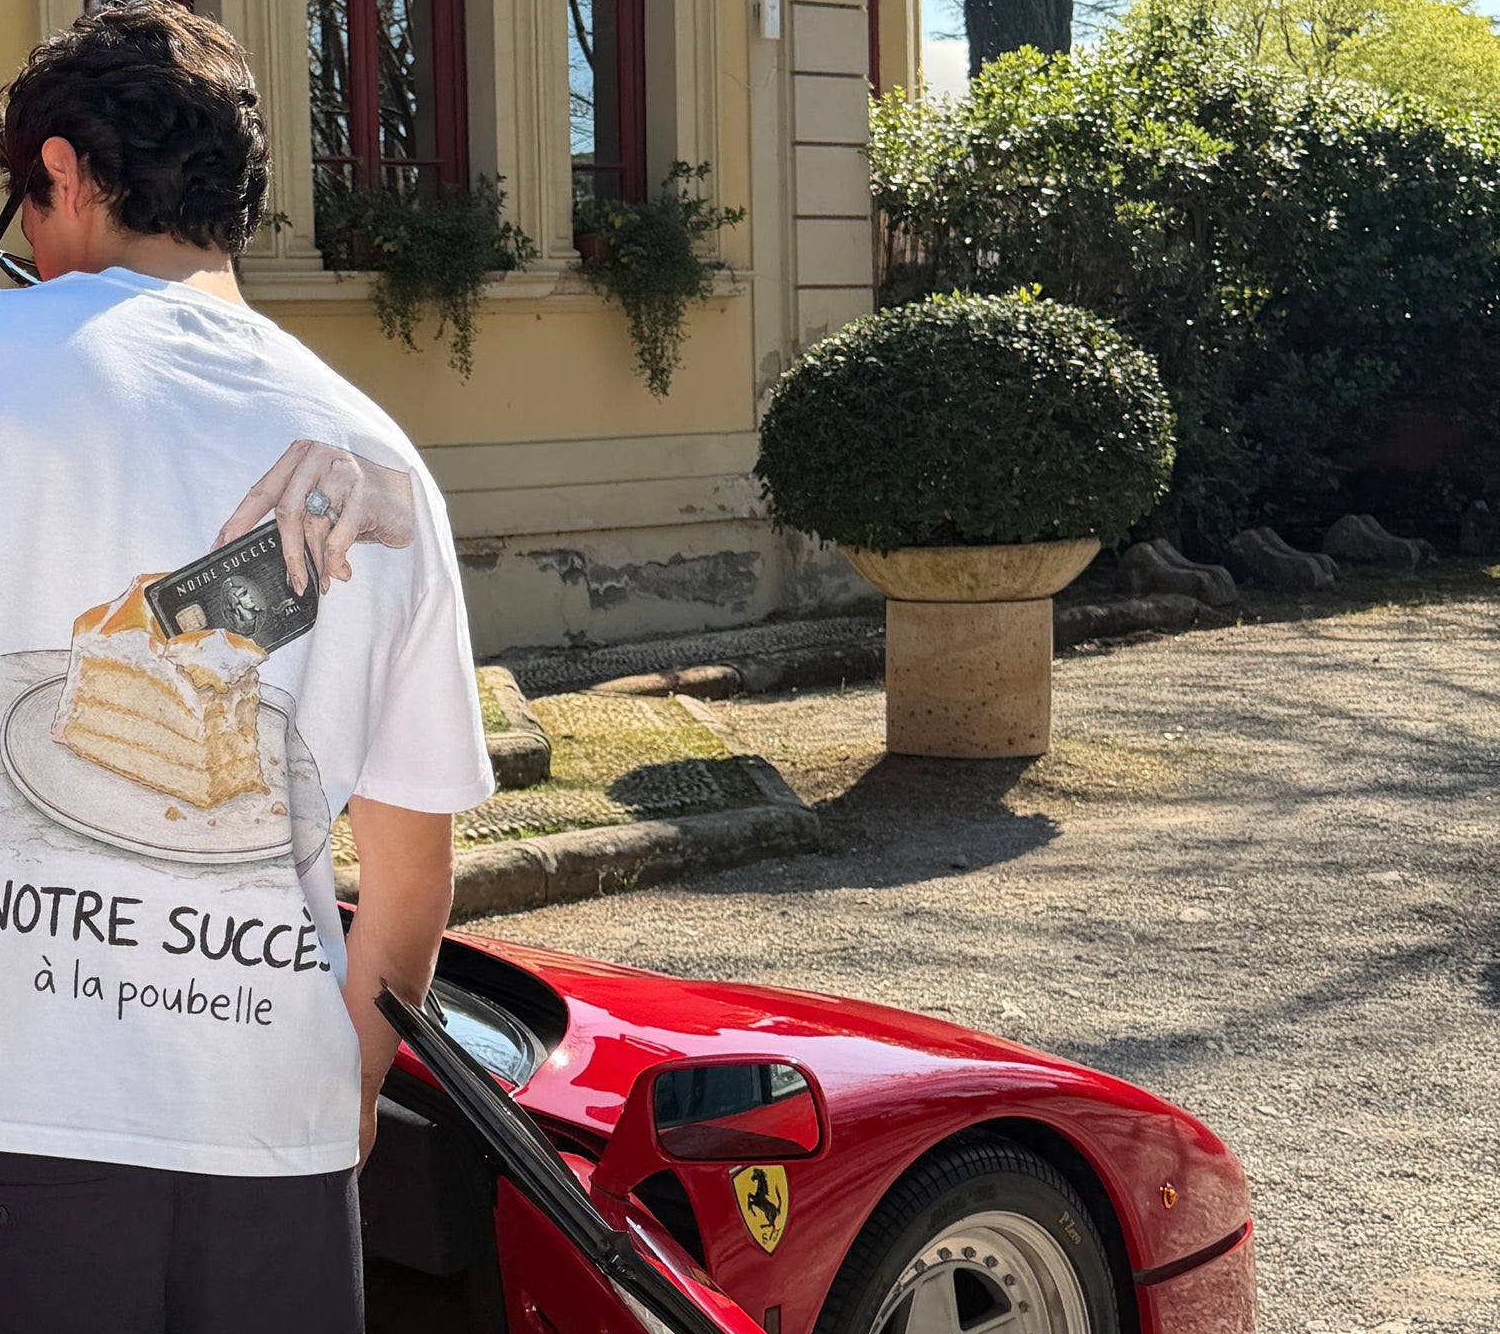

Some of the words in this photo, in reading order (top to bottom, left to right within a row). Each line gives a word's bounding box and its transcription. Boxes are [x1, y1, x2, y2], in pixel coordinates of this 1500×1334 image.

[176, 568, 218, 597] NOTRE
[222, 537, 276, 572] SUCCÈS
[34, 955, 56, 994] à
[73, 959, 104, 1001] la
[117, 978, 274, 1027] poubelle
[1060, 1211, 1070, 1224] P
